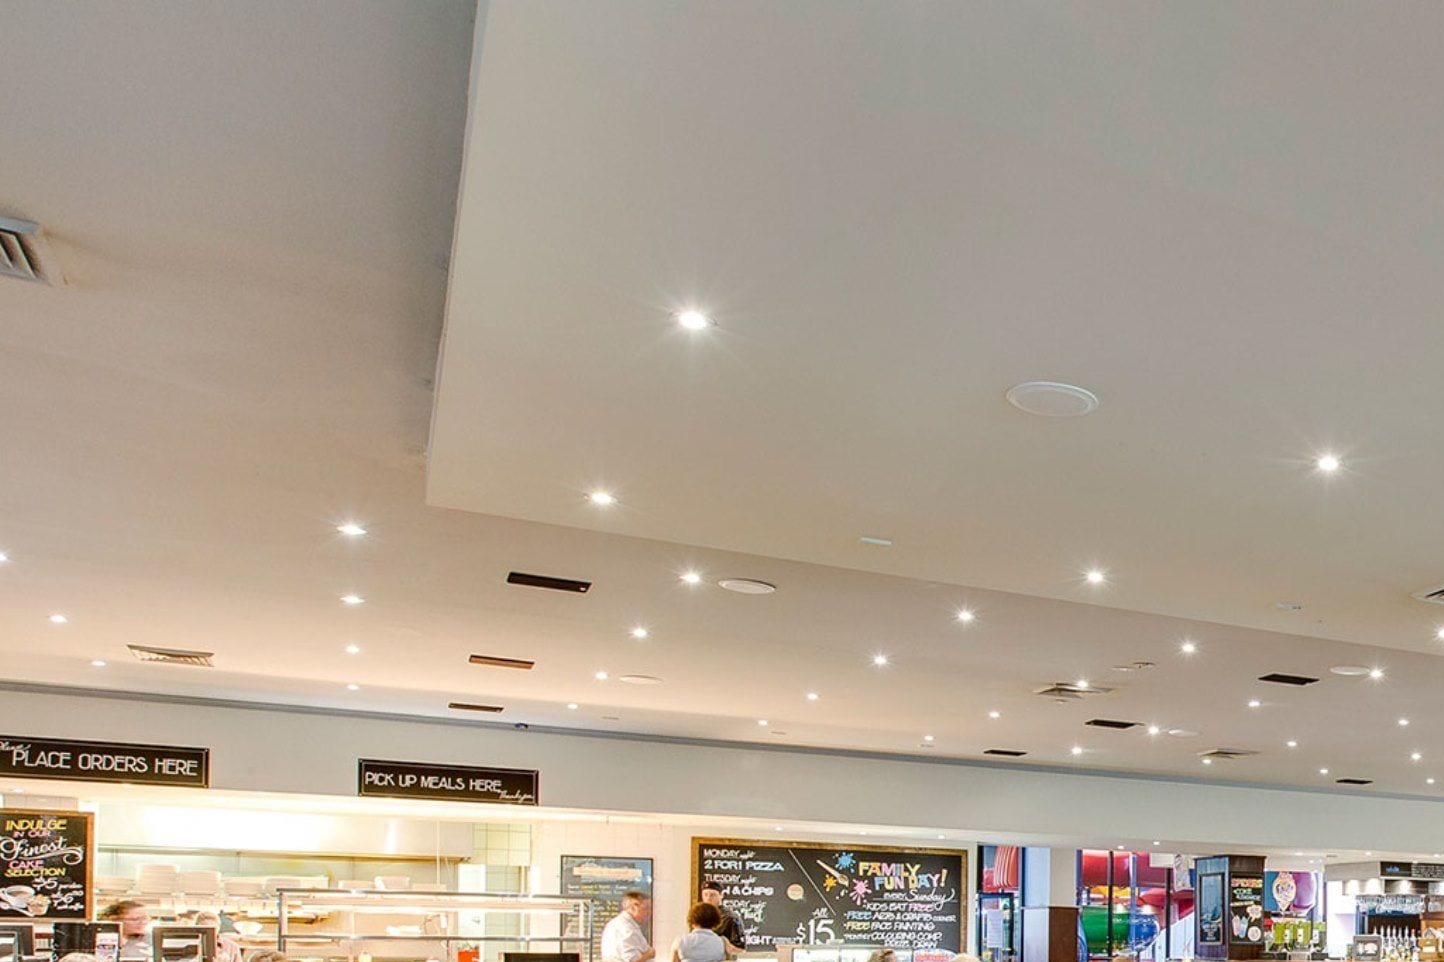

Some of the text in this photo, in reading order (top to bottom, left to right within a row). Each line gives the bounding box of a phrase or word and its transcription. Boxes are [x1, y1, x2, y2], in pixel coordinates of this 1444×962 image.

[12, 750, 198, 776] PLACE ORDERS HERE
[365, 772, 502, 793] PICK UP MEALS HERE
[5, 819, 67, 831] INDULGE
[28, 830, 55, 838] OUR
[0, 836, 76, 861] Finest
[703, 848, 740, 858] MONDAY
[8, 860, 45, 869] CAKE
[704, 860, 714, 870] 2
[714, 860, 739, 870] FOR
[745, 861, 785, 872] PIZZA
[858, 861, 921, 877] FAMILY
[4, 867, 66, 878] SELECTION
[704, 873, 741, 883] TUESDAY
[873, 868, 948, 890] FUN DAY!
[741, 886, 774, 896] CHIPS
[905, 888, 955, 911] Sunday
[865, 902, 934, 912] KIDS EAT FREE
[846, 911, 872, 920] FREE
[845, 921, 936, 931] FREE FACE PAINTING
[872, 932, 916, 941] COLOURING
